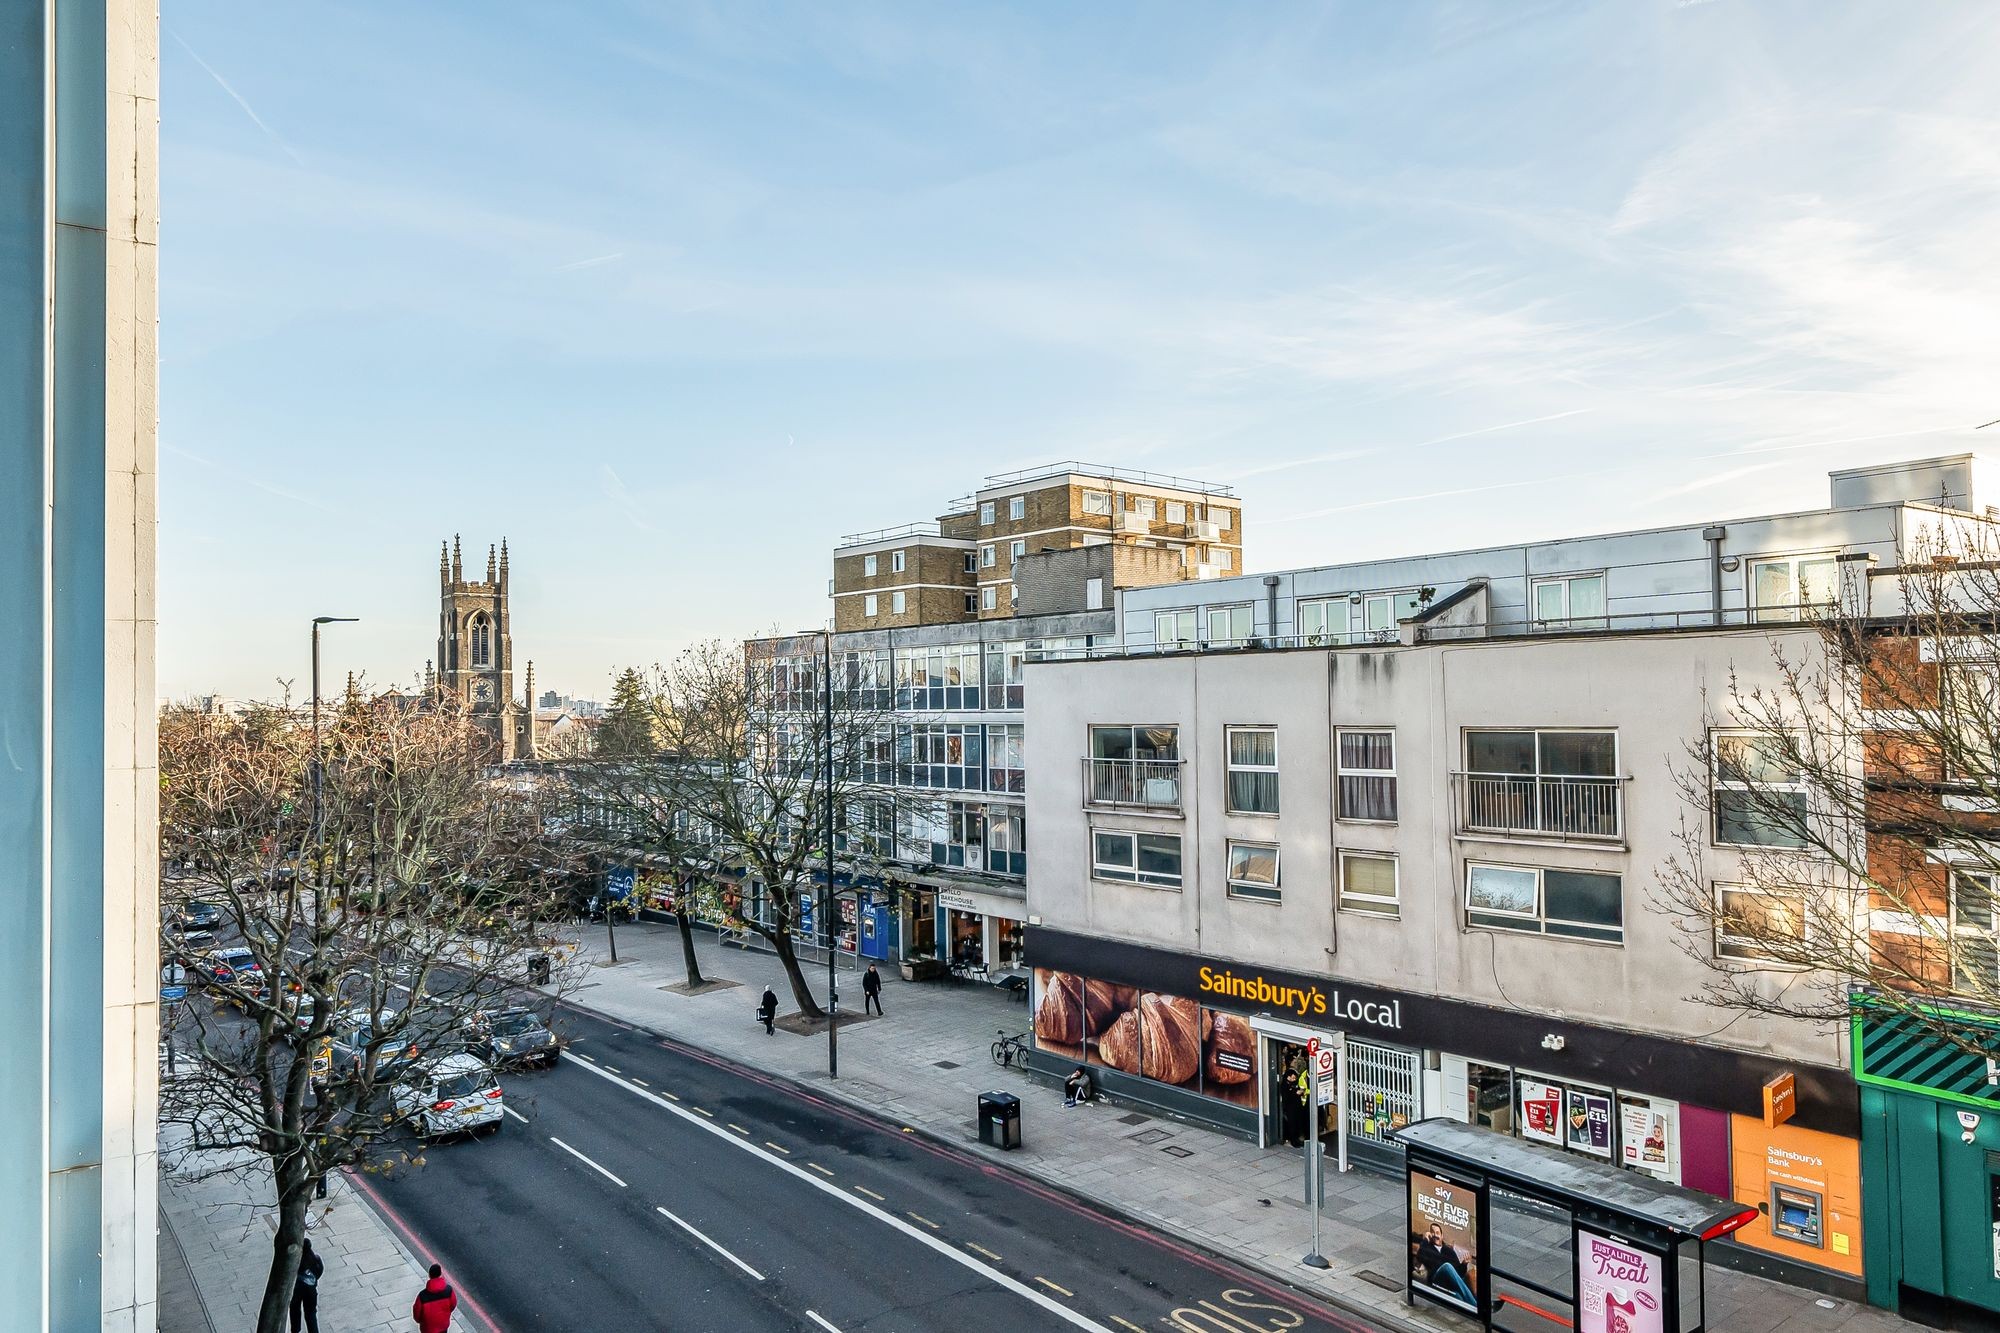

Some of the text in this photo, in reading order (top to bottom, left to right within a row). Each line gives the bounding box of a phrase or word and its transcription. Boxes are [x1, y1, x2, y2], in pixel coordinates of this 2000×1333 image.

[940, 894, 974, 905] BAKEHOUSE
[1199, 966, 1402, 1029] Sainsbury's Local
[1310, 1041, 1318, 1052] P
[1588, 1110, 1608, 1123] £15
[1767, 1145, 1823, 1167] Sainsbury's
[1768, 1156, 1790, 1168] Bank
[1434, 1186, 1452, 1201] sky
[1417, 1193, 1442, 1209] BEST
[1443, 1203, 1470, 1220] EVER
[1417, 1202, 1442, 1218] BLACK
[1443, 1213, 1470, 1228] FRIDAY
[1594, 1242, 1639, 1265] JUST A LITTLE
[1592, 1252, 1650, 1284] Treat
